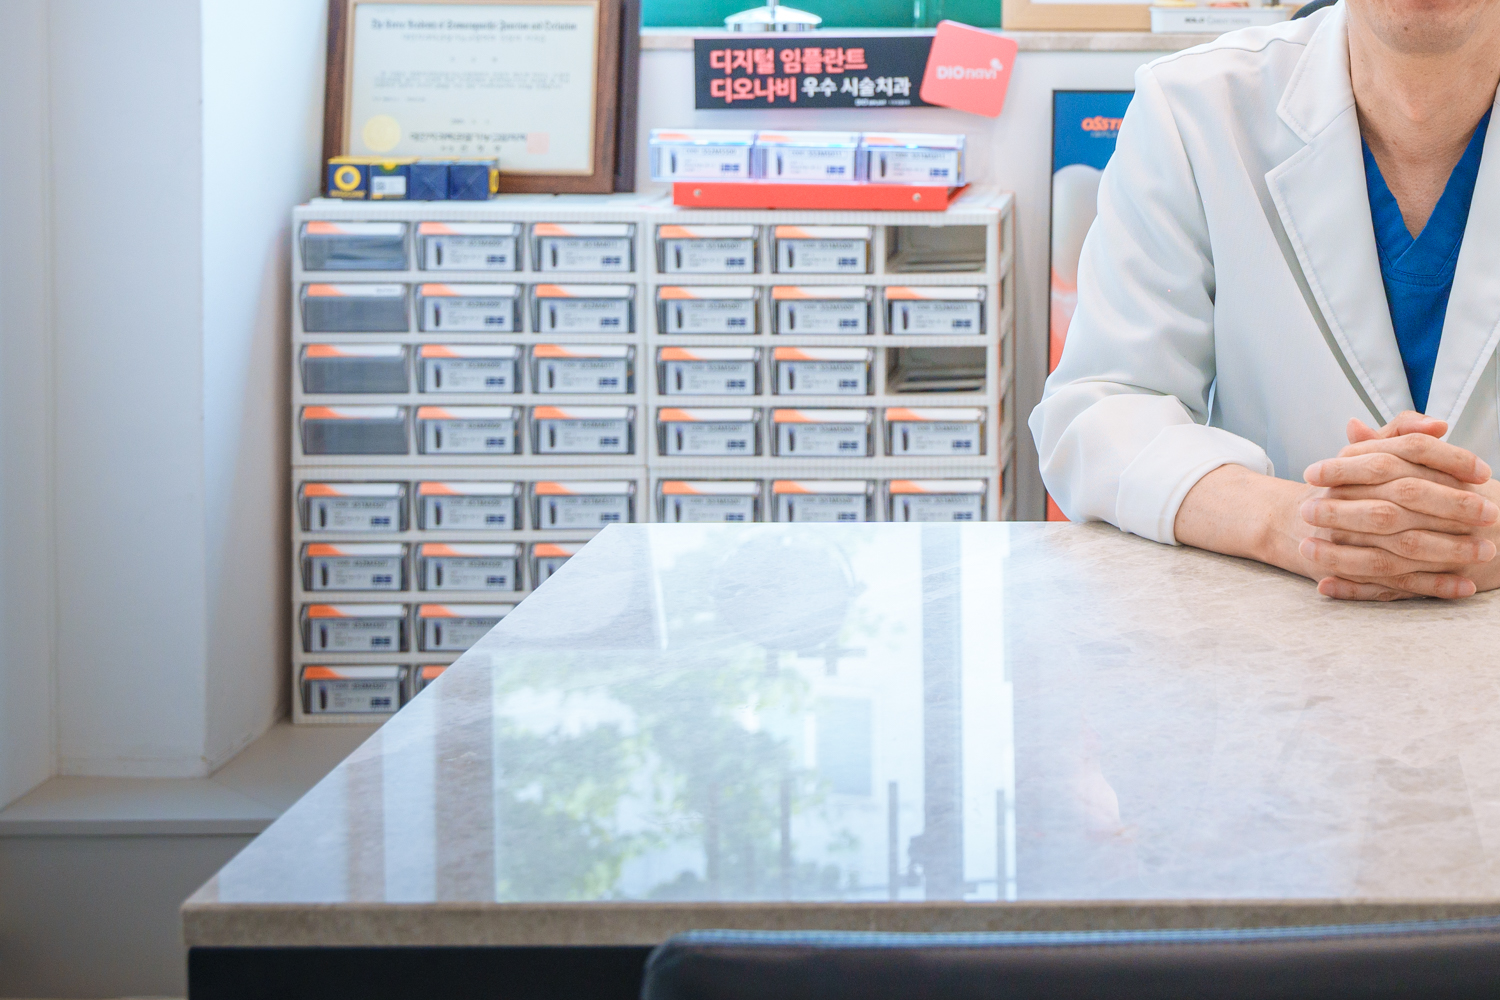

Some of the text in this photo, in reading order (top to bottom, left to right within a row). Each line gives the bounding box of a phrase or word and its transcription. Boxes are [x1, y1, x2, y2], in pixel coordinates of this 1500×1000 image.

[710, 48, 868, 74] 디지털 임플란트
[710, 76, 911, 102] 디오나비 우수 시술치과
